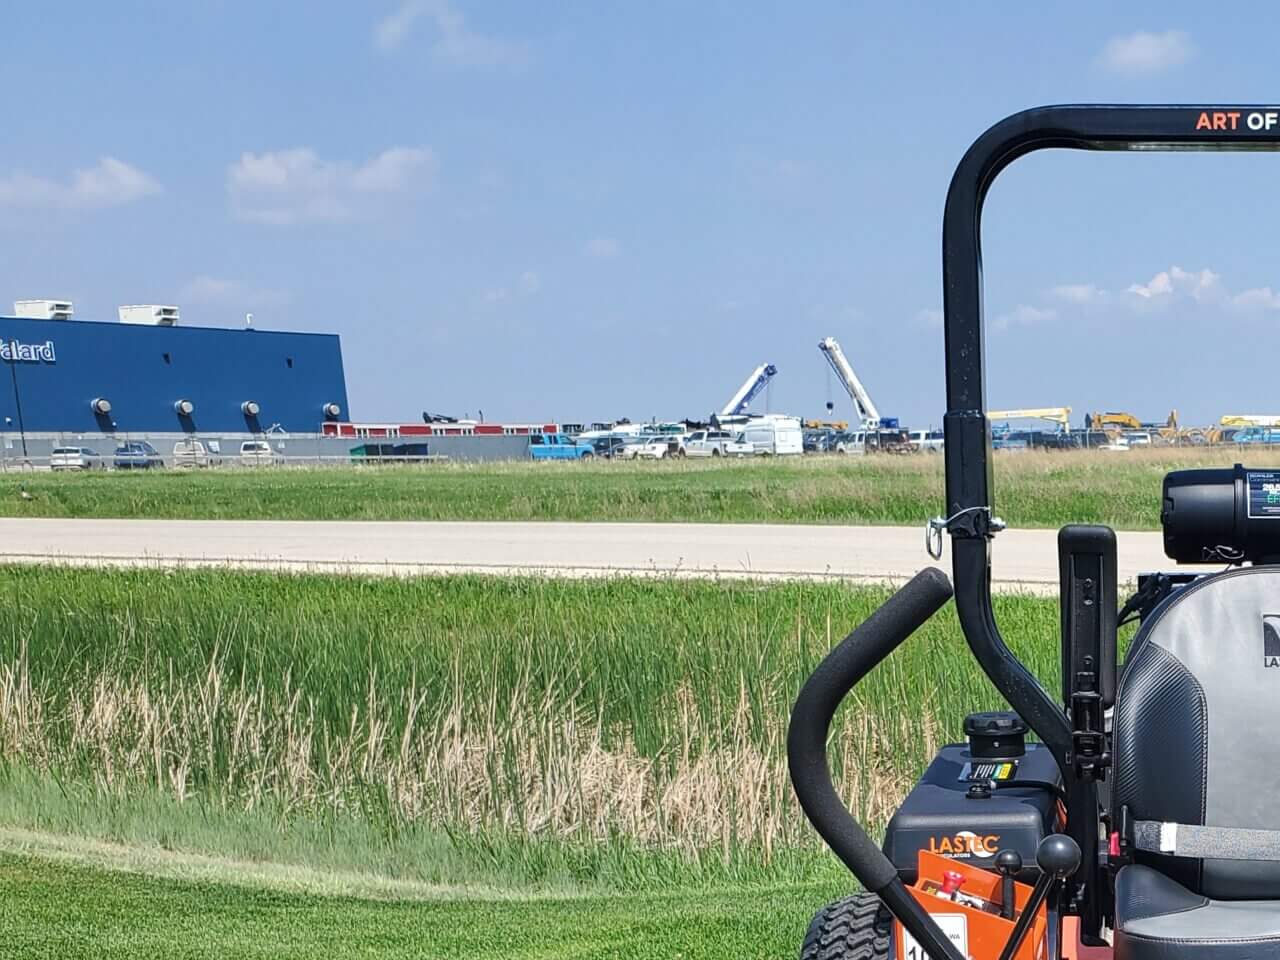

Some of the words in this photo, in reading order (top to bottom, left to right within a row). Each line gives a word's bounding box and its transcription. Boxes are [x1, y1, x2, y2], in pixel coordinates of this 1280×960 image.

[1195, 112, 1240, 130] ART
[1247, 112, 1278, 130] OF
[0, 338, 56, 361] alard
[930, 835, 999, 853] LASTEC
